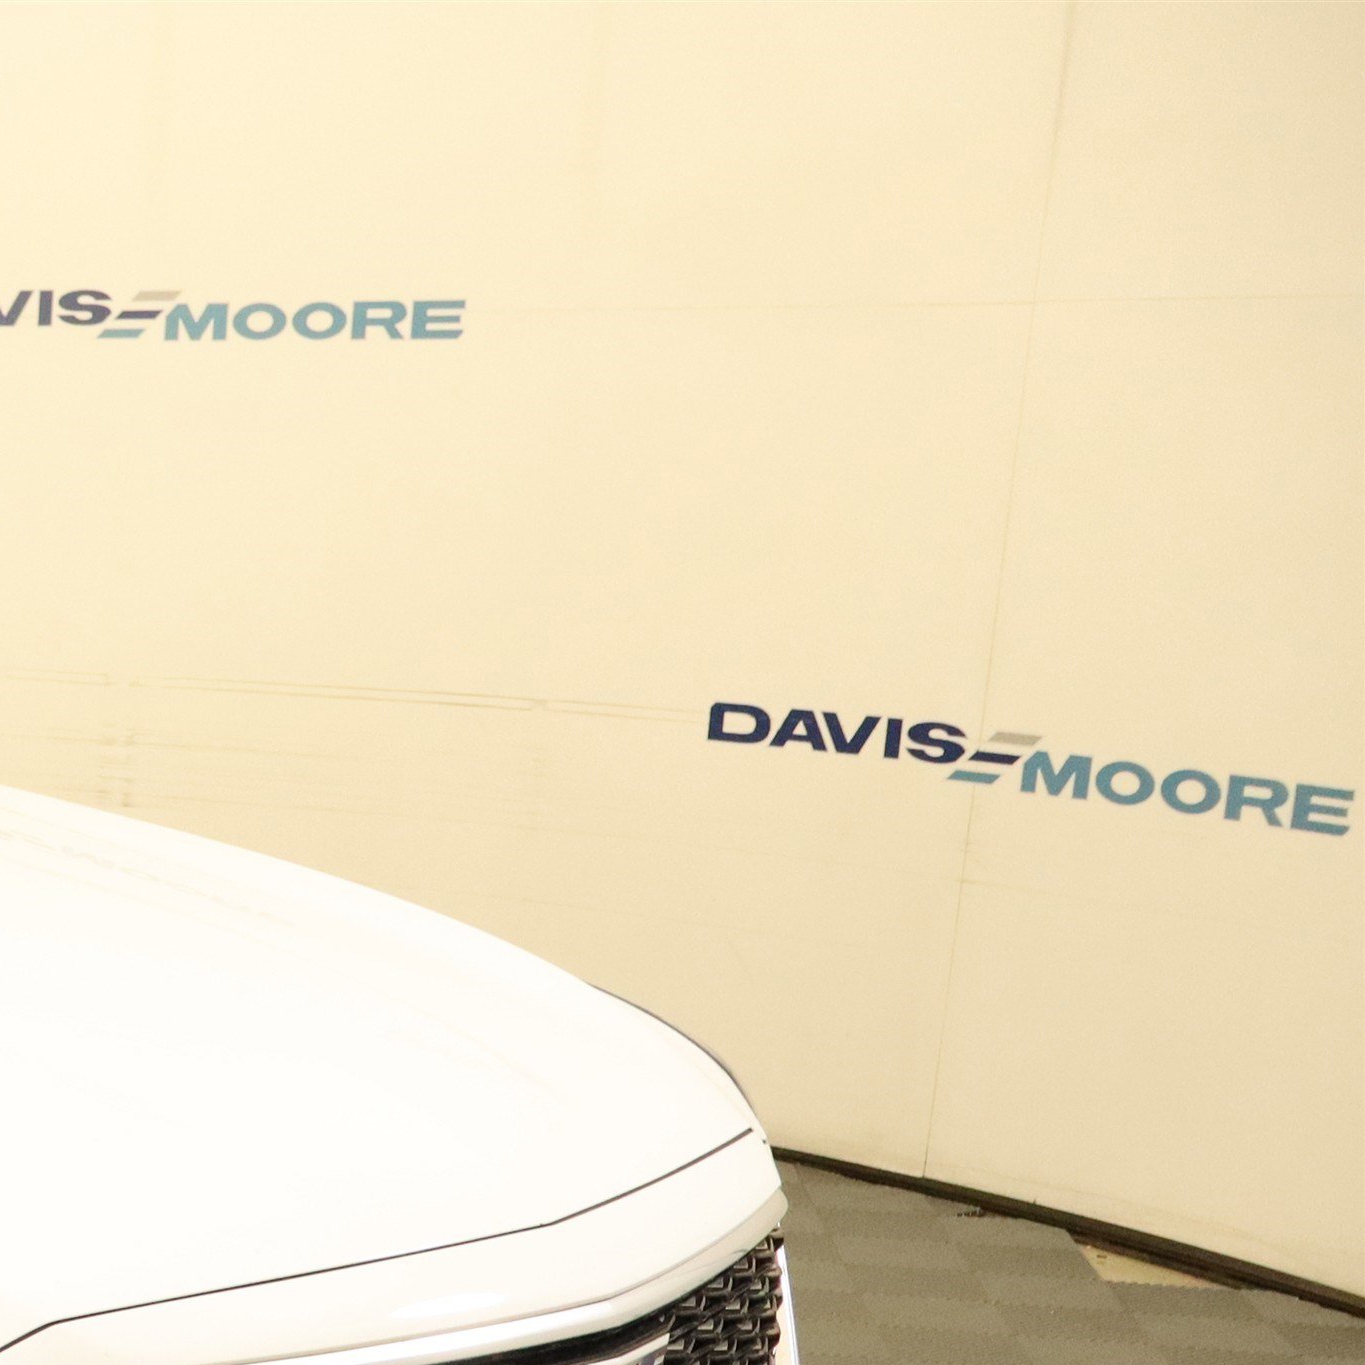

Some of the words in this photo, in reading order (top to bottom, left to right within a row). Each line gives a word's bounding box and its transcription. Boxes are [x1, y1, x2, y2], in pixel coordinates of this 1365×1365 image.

[165, 301, 466, 341] MOORE
[707, 702, 967, 764] DAVIS
[1020, 751, 1354, 836] MOORE
